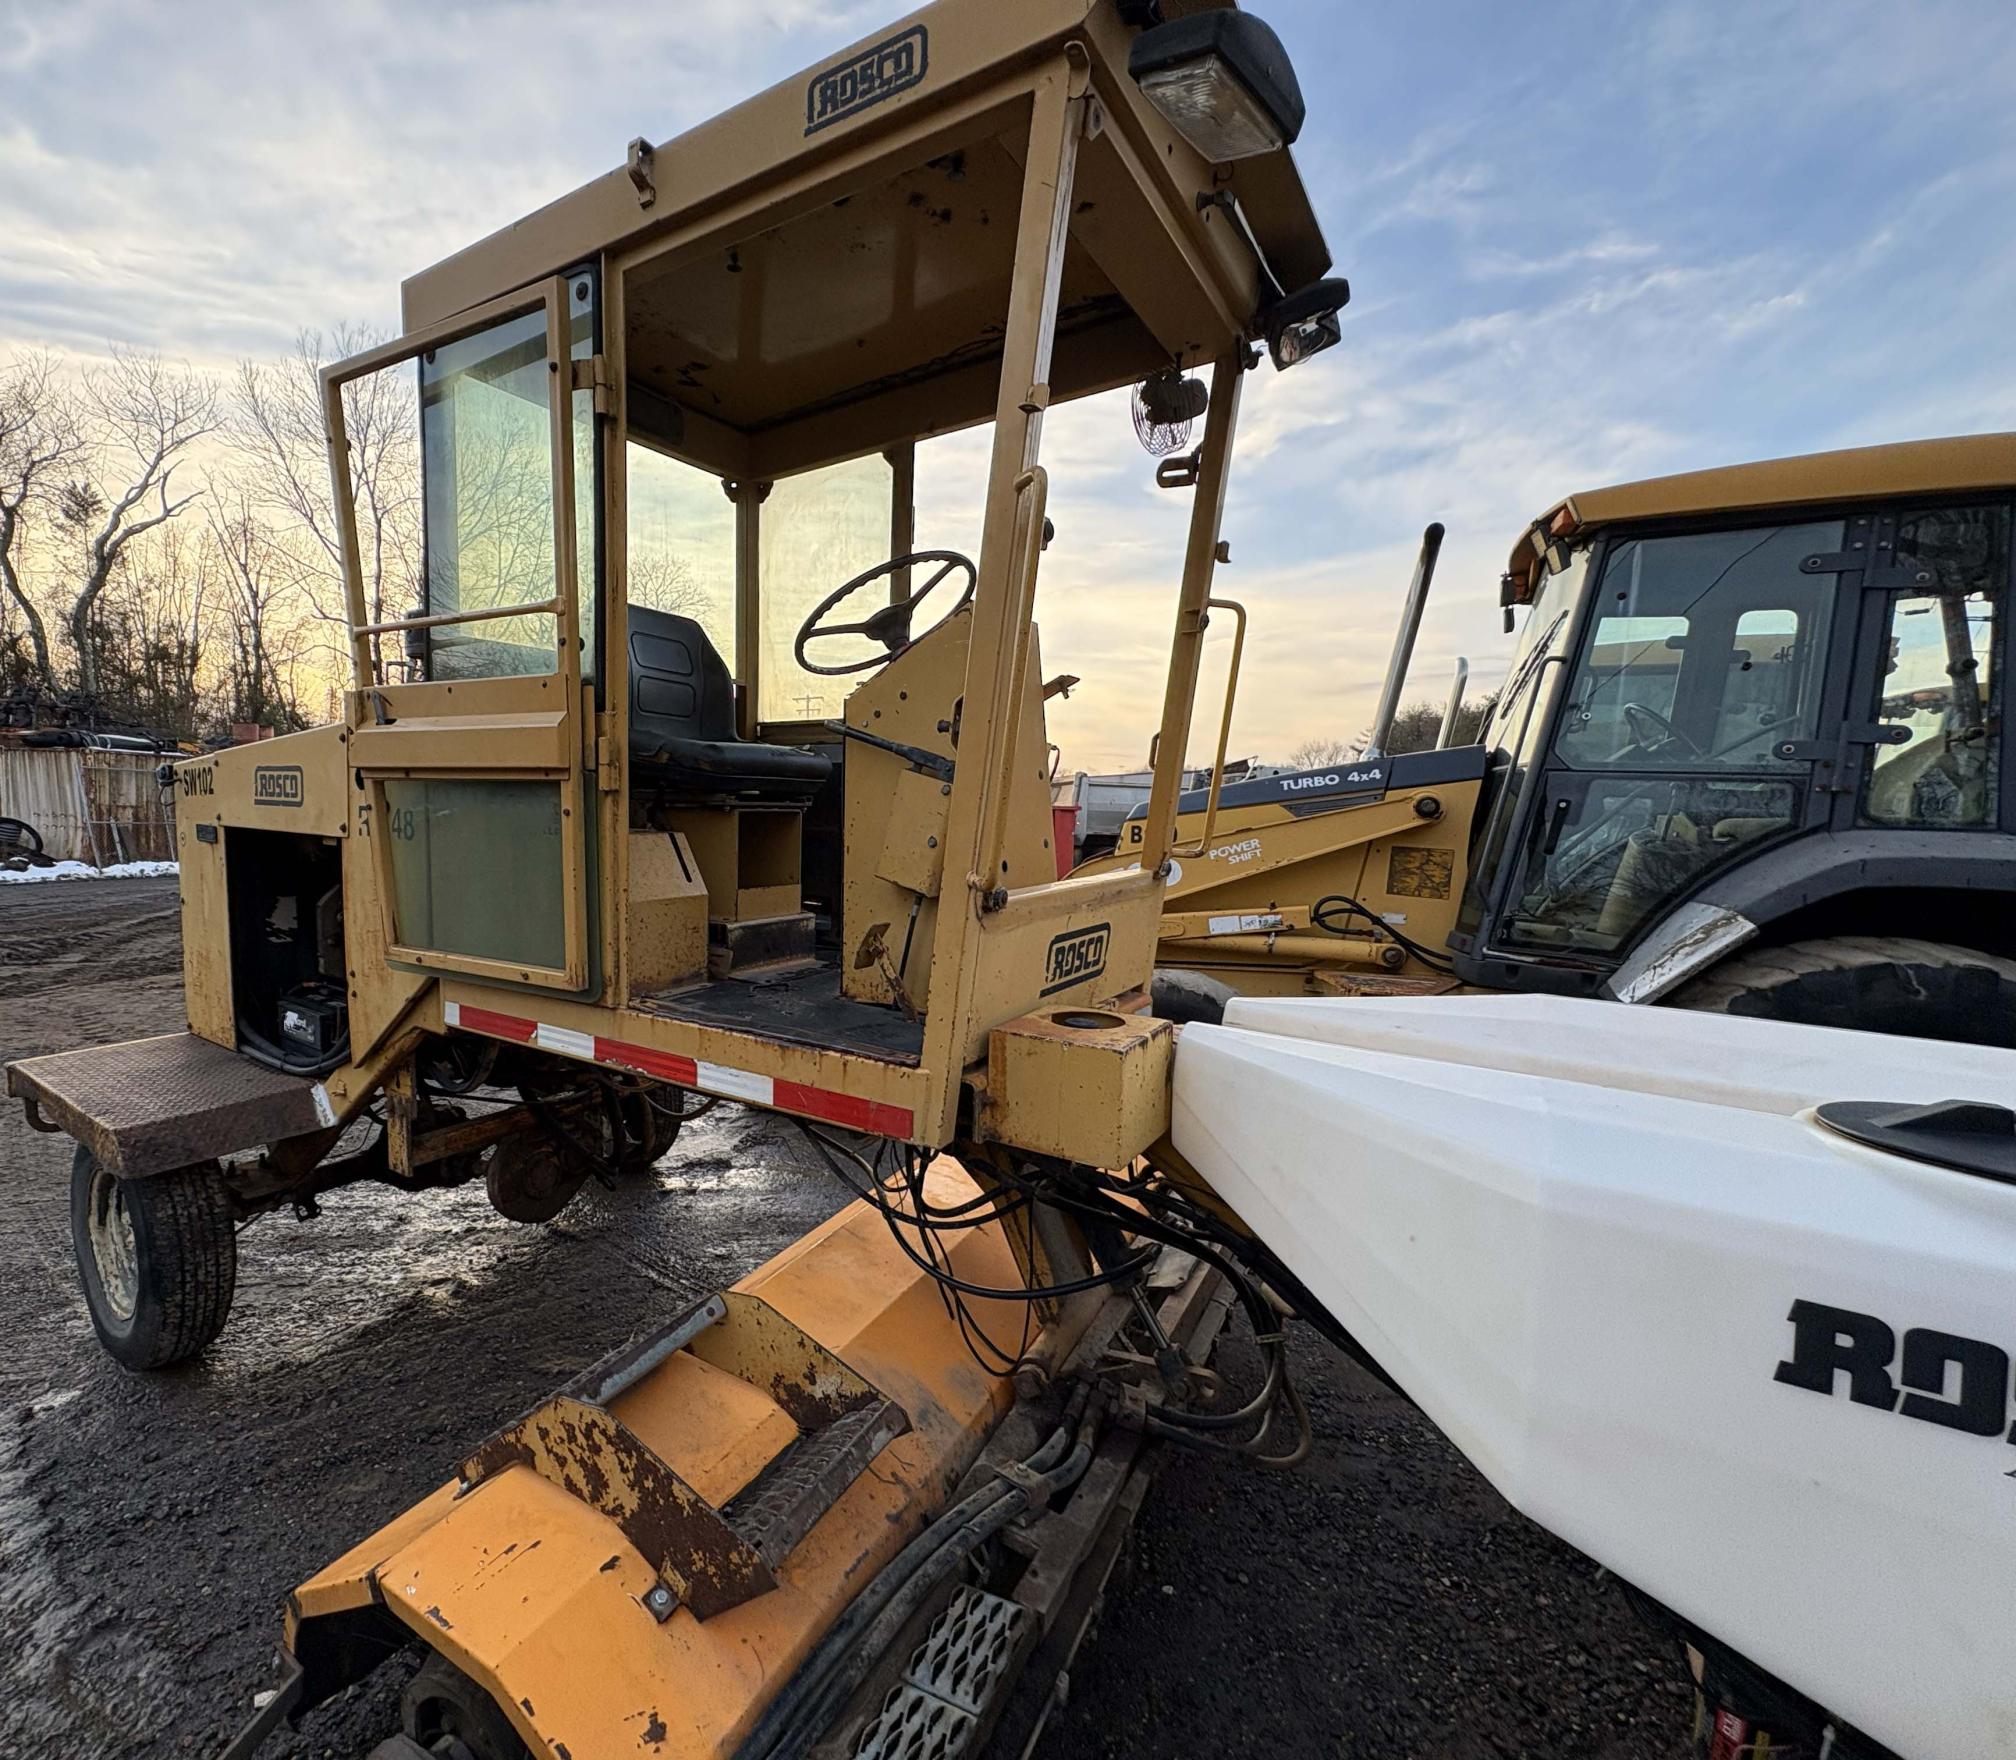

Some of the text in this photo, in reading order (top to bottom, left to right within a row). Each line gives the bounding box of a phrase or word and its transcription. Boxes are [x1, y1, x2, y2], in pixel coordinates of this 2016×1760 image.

[816, 42, 913, 119] ROSCO
[184, 766, 214, 798] SW102
[259, 773, 299, 799] ROSCO
[1279, 769, 1382, 791] TURBO 4x4
[1208, 838, 1261, 860] POWER
[1228, 848, 1262, 865] SHIFT
[1049, 935, 1104, 982] ROSCO
[1773, 1299, 2016, 1446] RO
